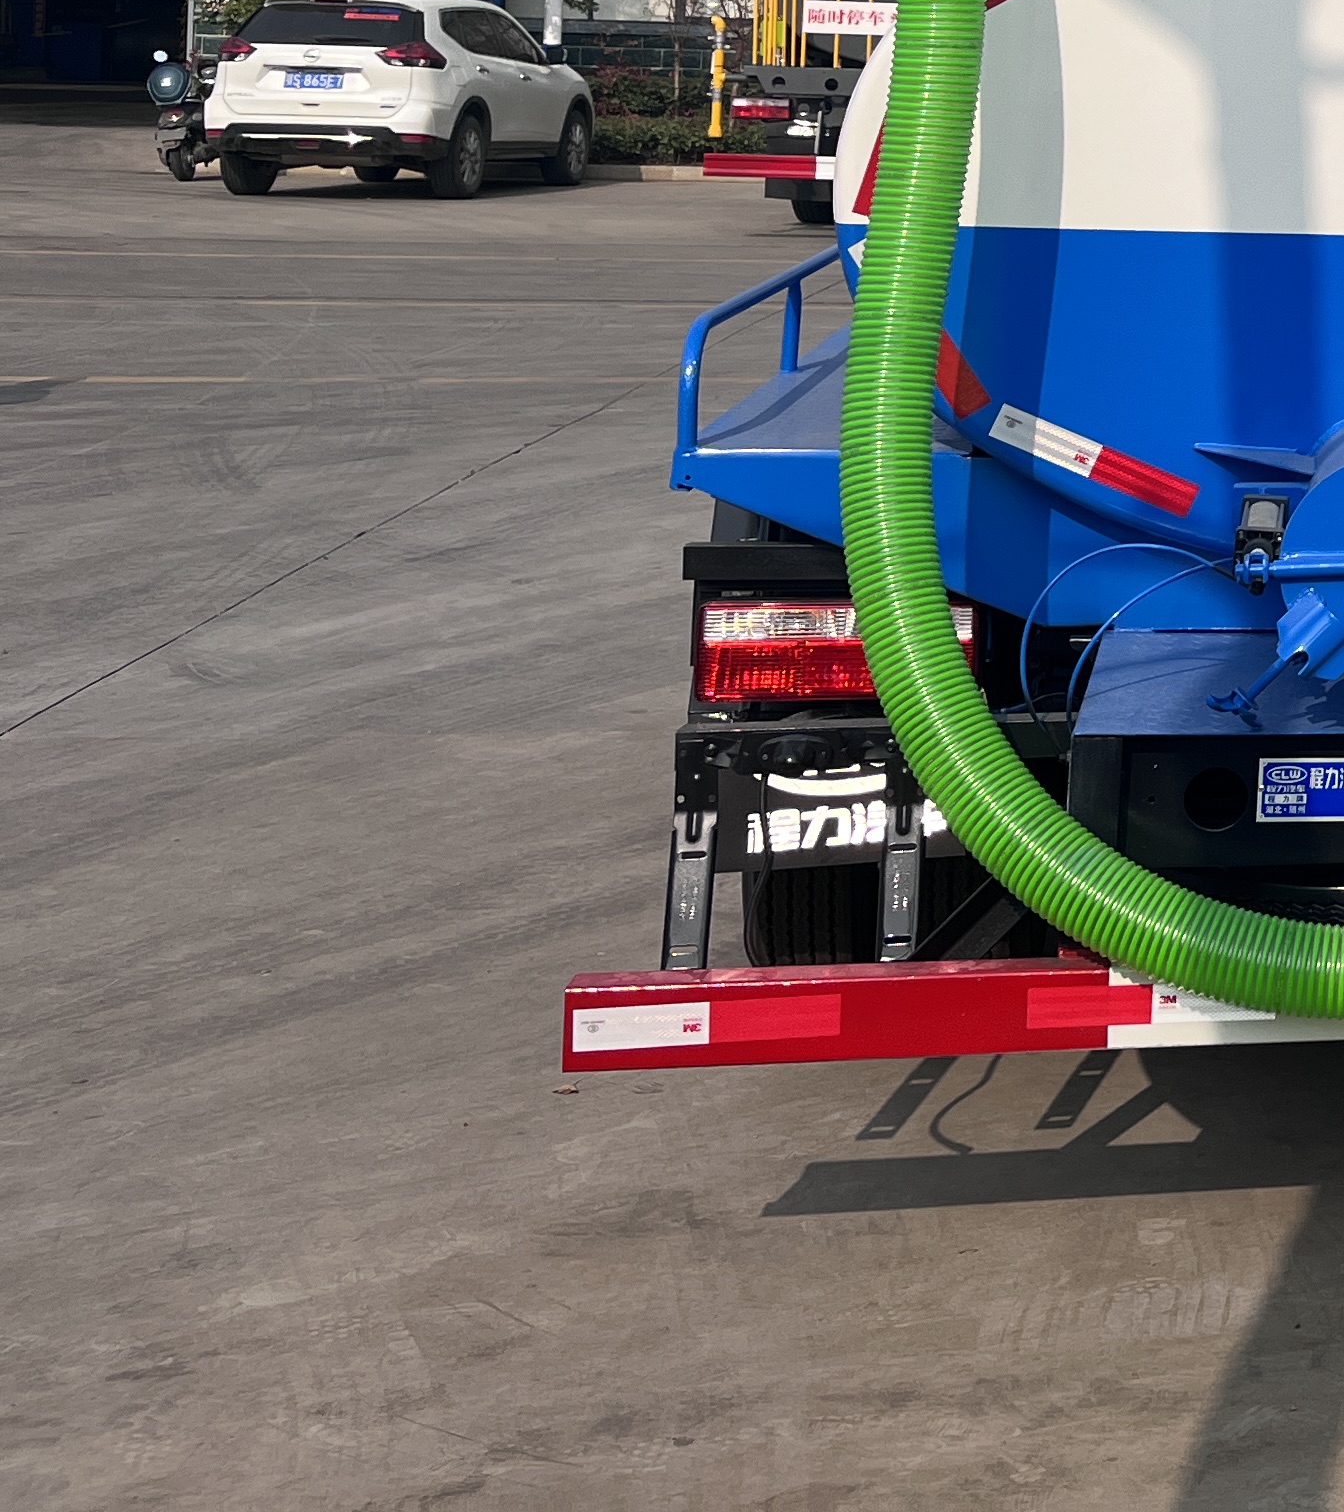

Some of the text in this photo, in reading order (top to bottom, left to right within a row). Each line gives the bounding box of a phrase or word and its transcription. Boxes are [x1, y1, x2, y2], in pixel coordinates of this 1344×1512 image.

[807, 8, 885, 26] 随时停车
[1270, 770, 1302, 780] CLW
[1159, 995, 1177, 1004] 3M
[683, 1023, 702, 1033] 3M
